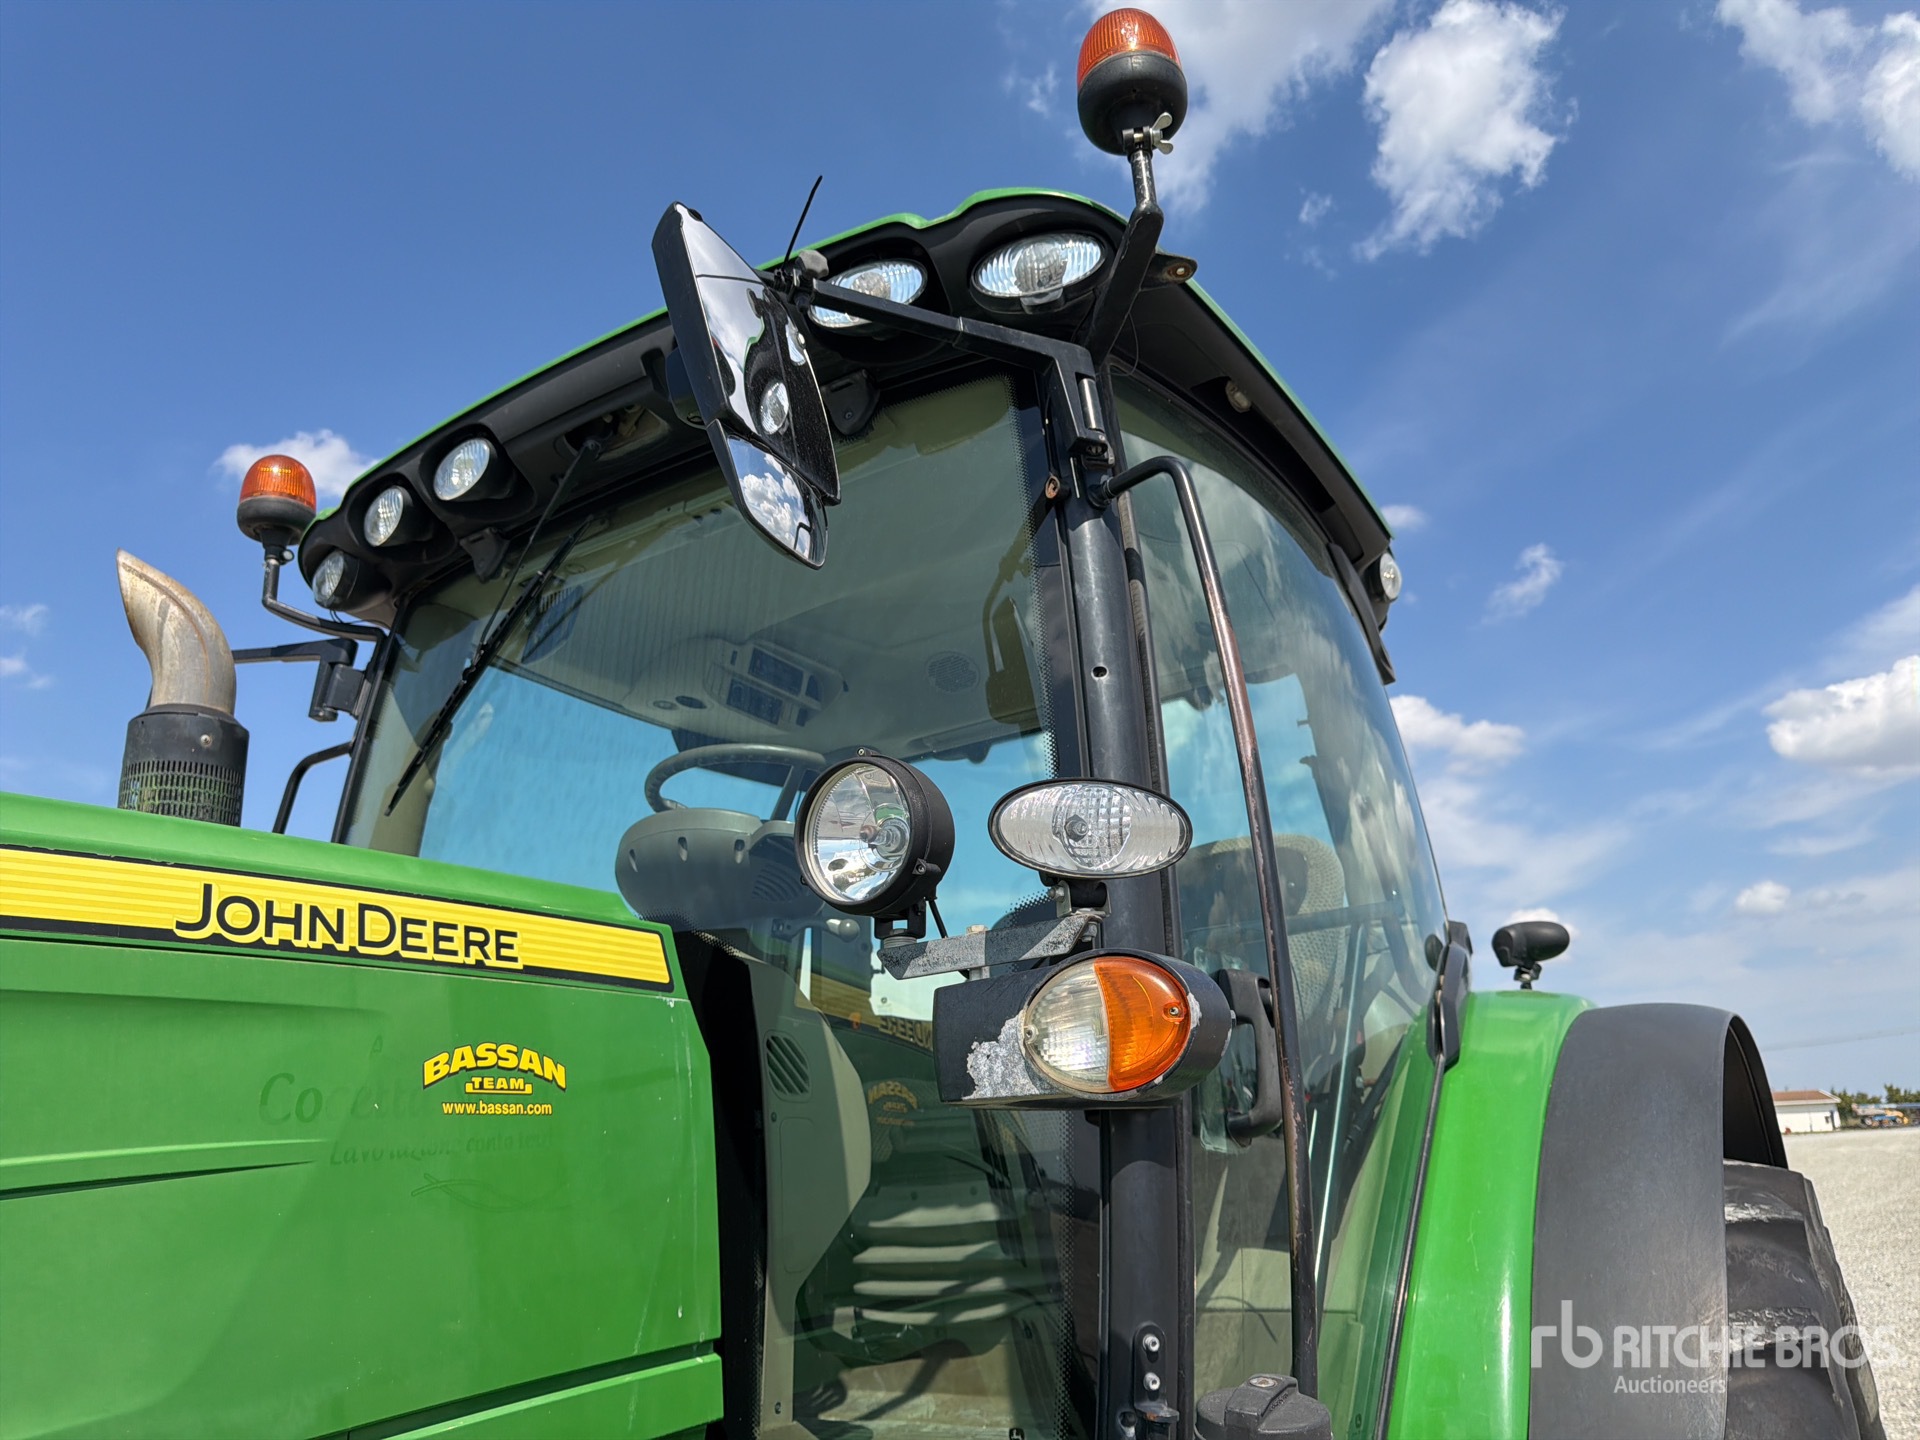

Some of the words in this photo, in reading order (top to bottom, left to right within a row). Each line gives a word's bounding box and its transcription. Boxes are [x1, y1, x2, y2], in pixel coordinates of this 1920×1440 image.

[174, 883, 347, 948] JOHN
[357, 903, 520, 965] DEERE
[423, 1042, 566, 1090] BASSAN
[471, 1076, 525, 1090] TEAM
[442, 1100, 553, 1115] www.bassan.com
